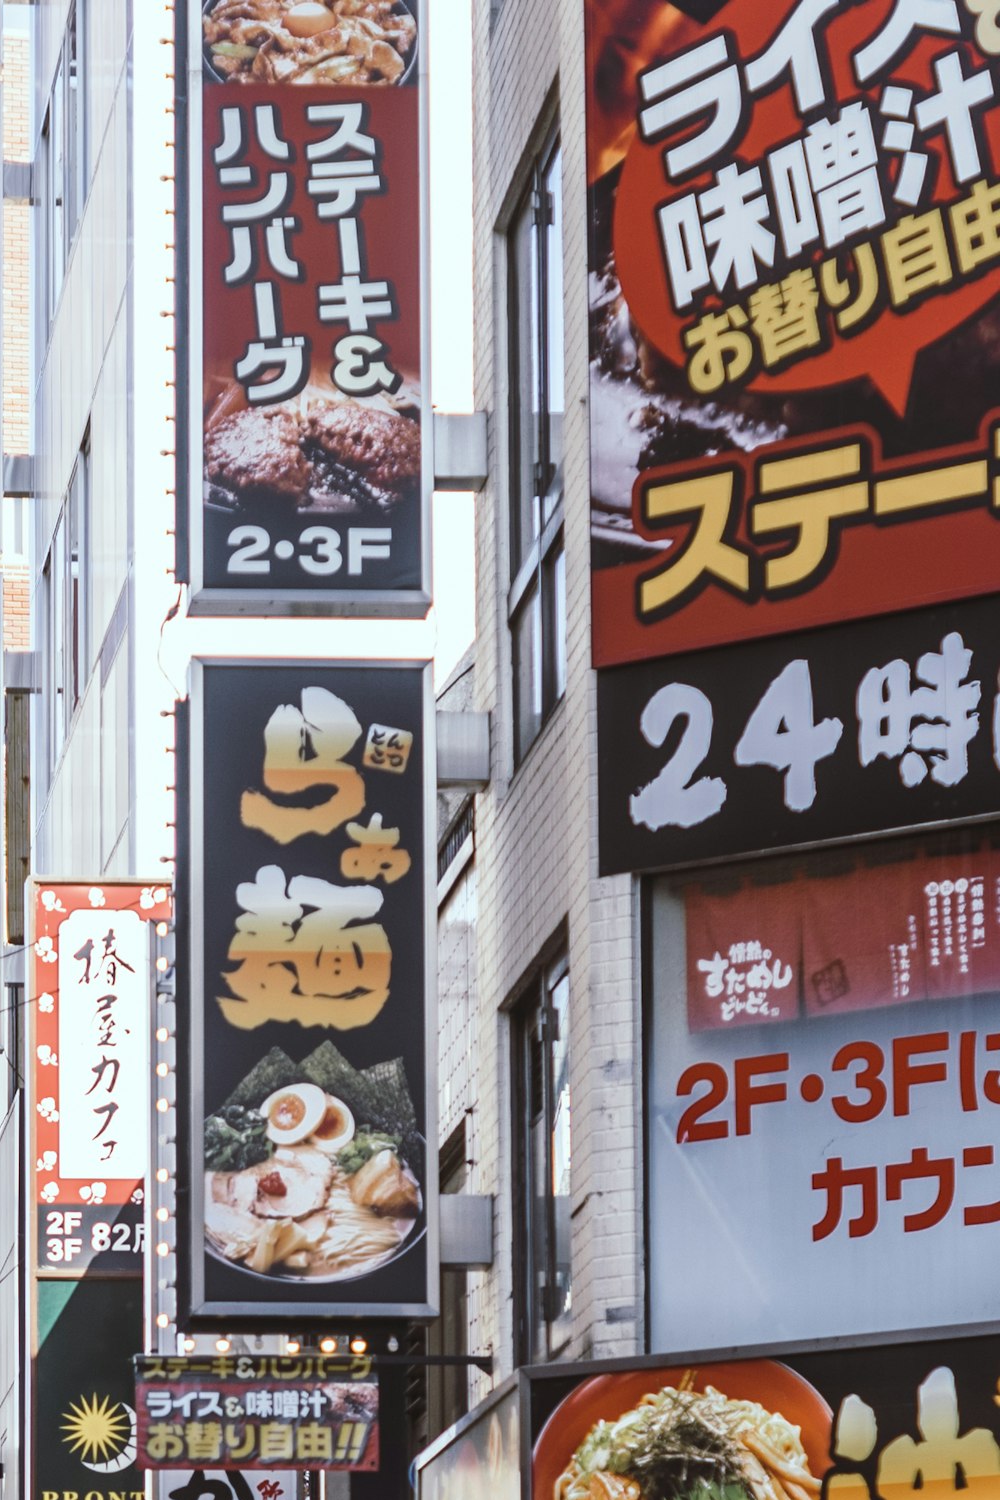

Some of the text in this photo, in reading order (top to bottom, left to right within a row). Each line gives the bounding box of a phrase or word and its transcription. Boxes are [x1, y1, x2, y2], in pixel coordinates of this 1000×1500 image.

[213, 105, 305, 401] ハンバーグ
[659, 51, 994, 310] 味噌汁
[641, 429, 1000, 614] ステー
[629, 631, 1000, 832] 24時
[46, 1211, 83, 1236] 2F
[46, 1237, 83, 1262] 3F
[146, 1391, 327, 1418] ライス&味噌汁
